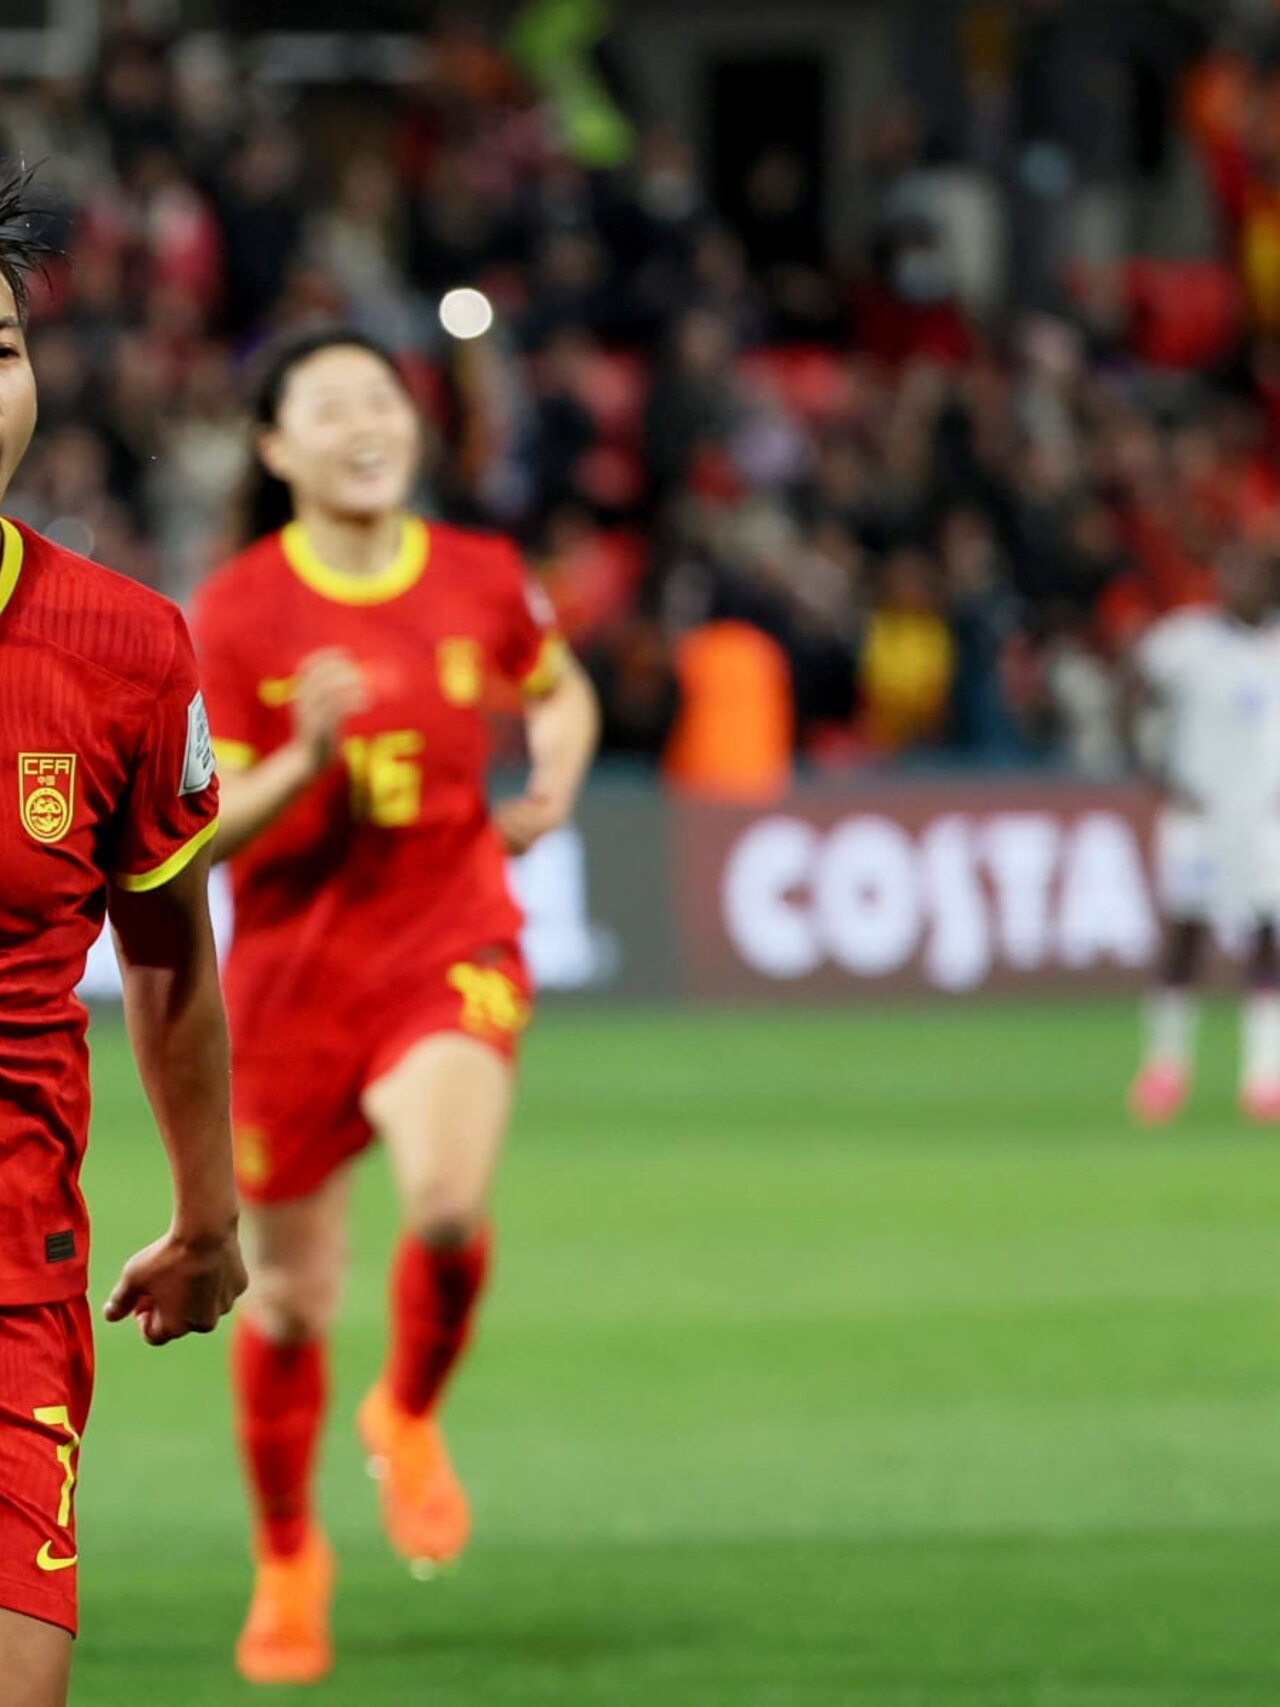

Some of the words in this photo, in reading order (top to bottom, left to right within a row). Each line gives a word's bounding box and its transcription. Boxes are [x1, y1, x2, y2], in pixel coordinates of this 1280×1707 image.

[24, 759, 70, 774] CFA
[342, 730, 425, 828] 16
[723, 811, 1161, 993] COSTA
